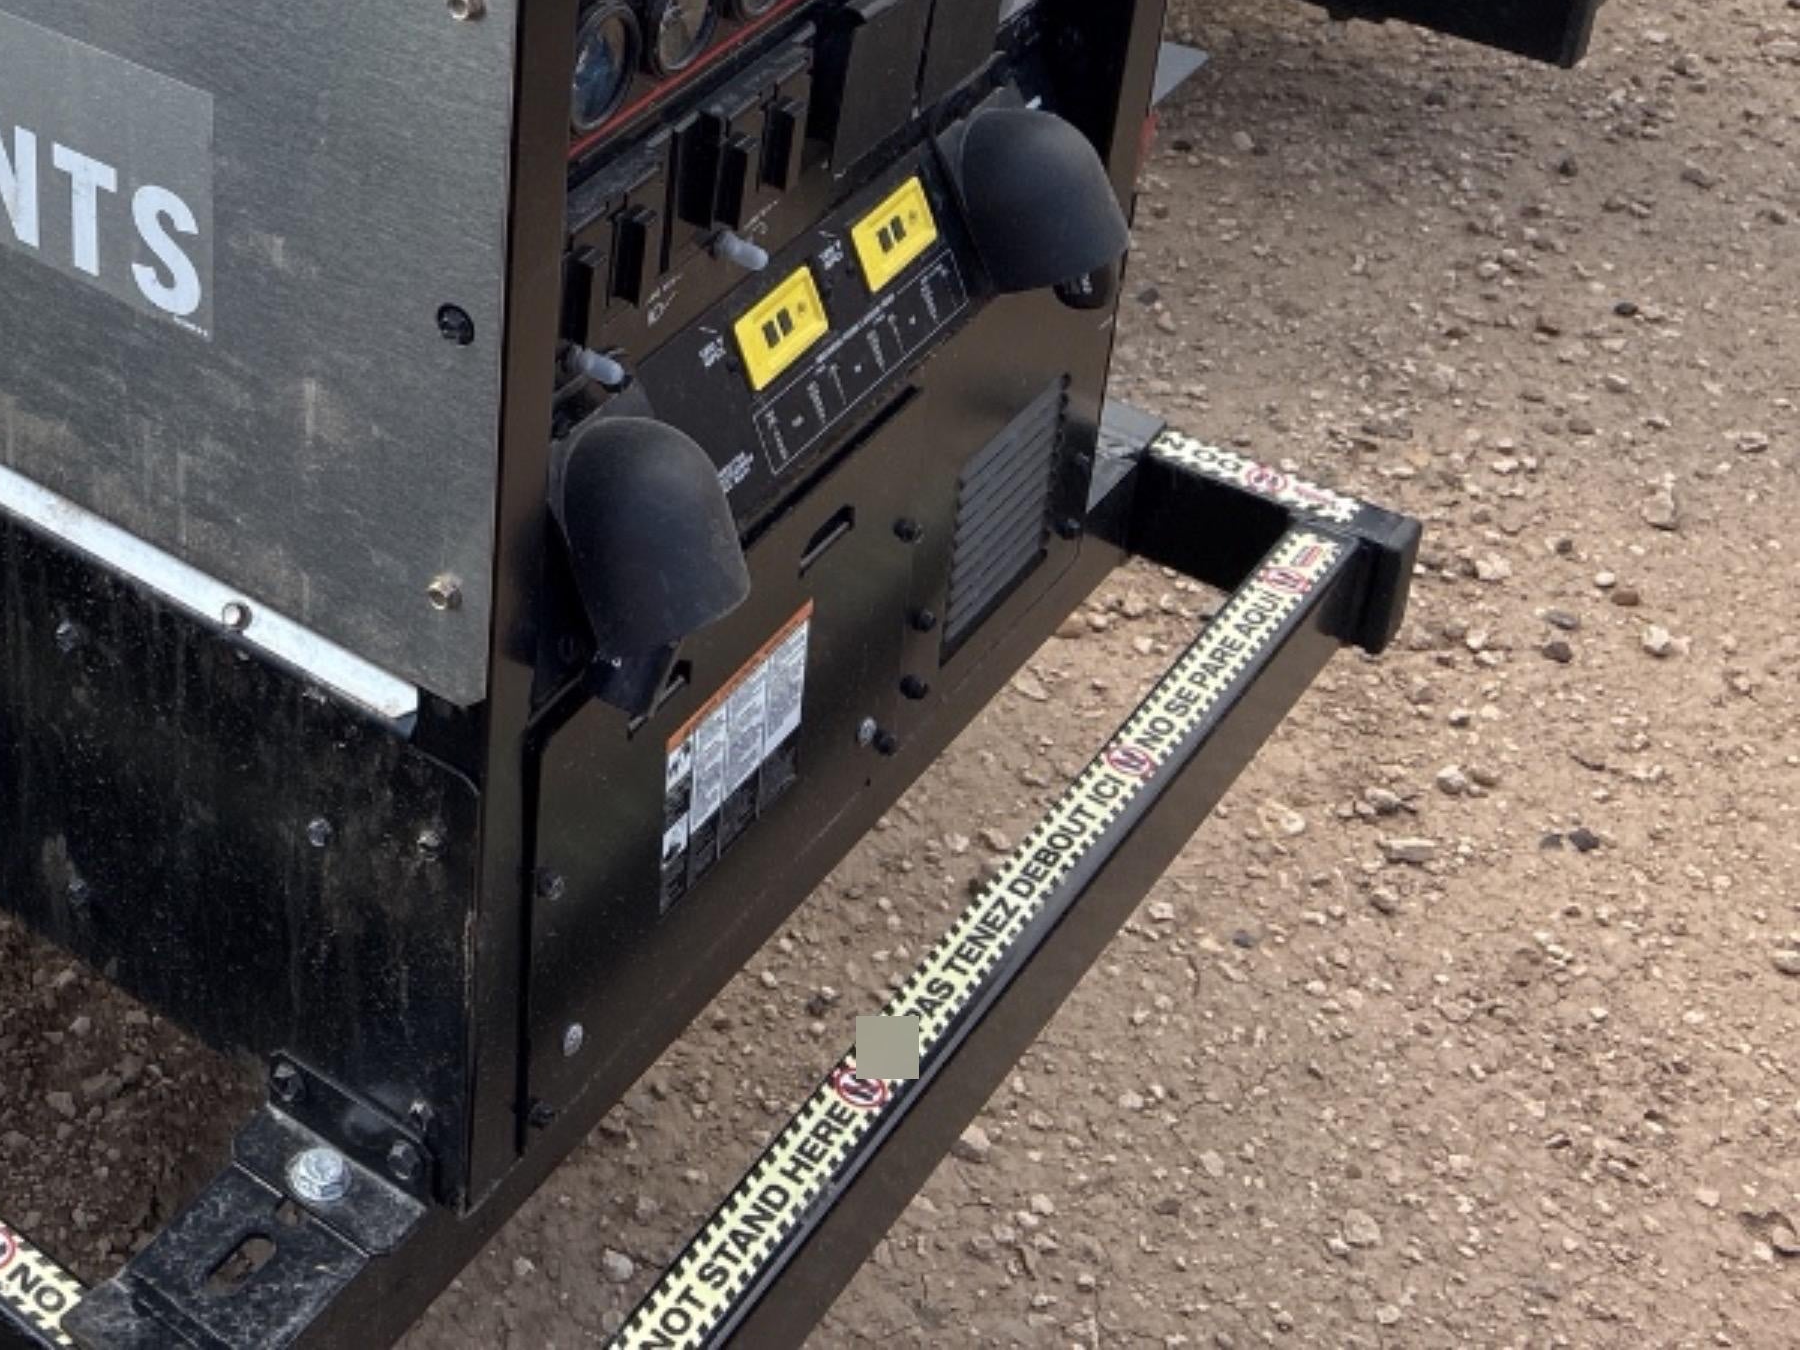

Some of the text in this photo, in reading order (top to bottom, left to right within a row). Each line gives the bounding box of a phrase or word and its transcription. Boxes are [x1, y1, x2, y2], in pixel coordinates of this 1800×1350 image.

[1140, 590, 1289, 751] NO SE PARE AQUI
[941, 897, 1022, 977] TENEZ
[1007, 804, 1097, 899] DEBOUT
[1091, 773, 1128, 810] ICI
[697, 1182, 793, 1291] STAND
[779, 1100, 859, 1188] HERE
[4, 1263, 69, 1314] NO
